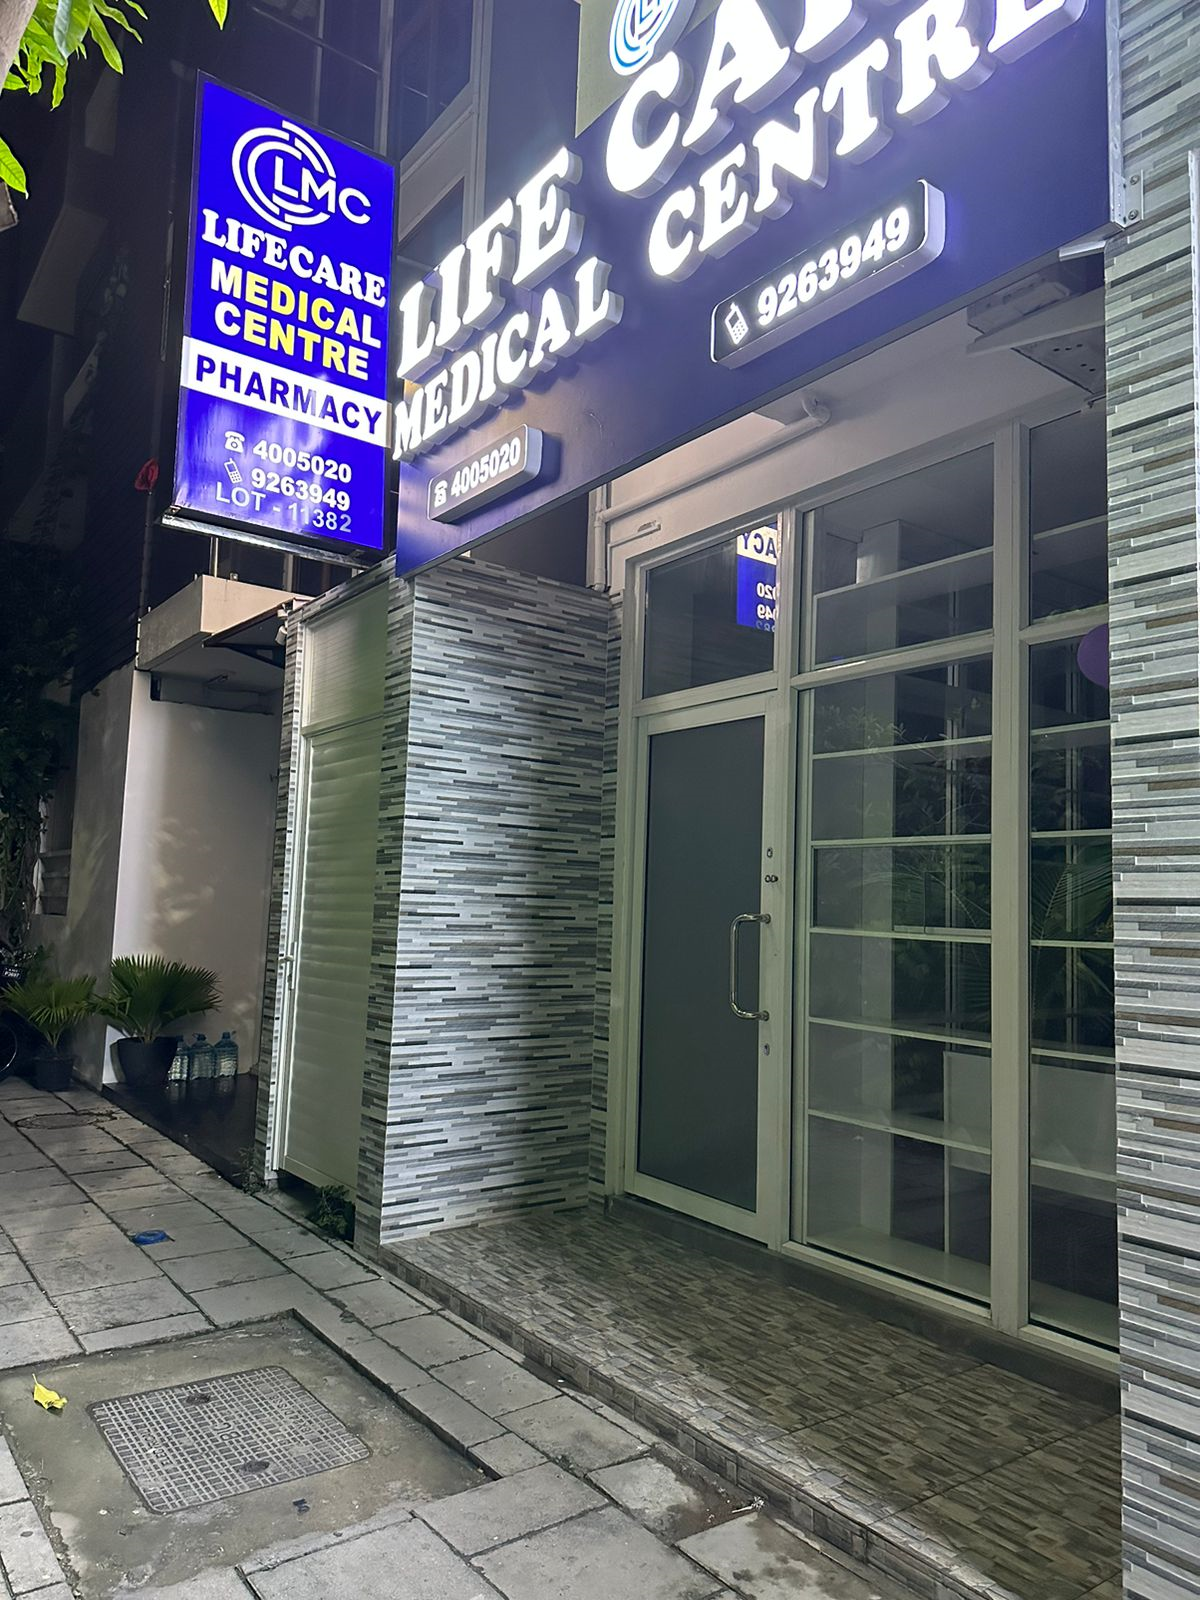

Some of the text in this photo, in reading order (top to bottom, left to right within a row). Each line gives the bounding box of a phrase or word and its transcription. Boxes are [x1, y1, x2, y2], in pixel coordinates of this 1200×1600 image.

[396, 0, 855, 378] LIFE CA
[202, 208, 386, 307] LIFECARE
[757, 206, 910, 326] 9263949
[210, 258, 382, 348] MEDICAL
[214, 301, 369, 381] CENTRE
[196, 354, 382, 434] PHARMACY
[391, 256, 612, 462] MEDICAL
[251, 468, 350, 511] 9263949
[253, 439, 352, 483] 4005020
[450, 436, 521, 497] 4005020
[216, 481, 266, 511] LOT
[289, 502, 352, 532] 11382
